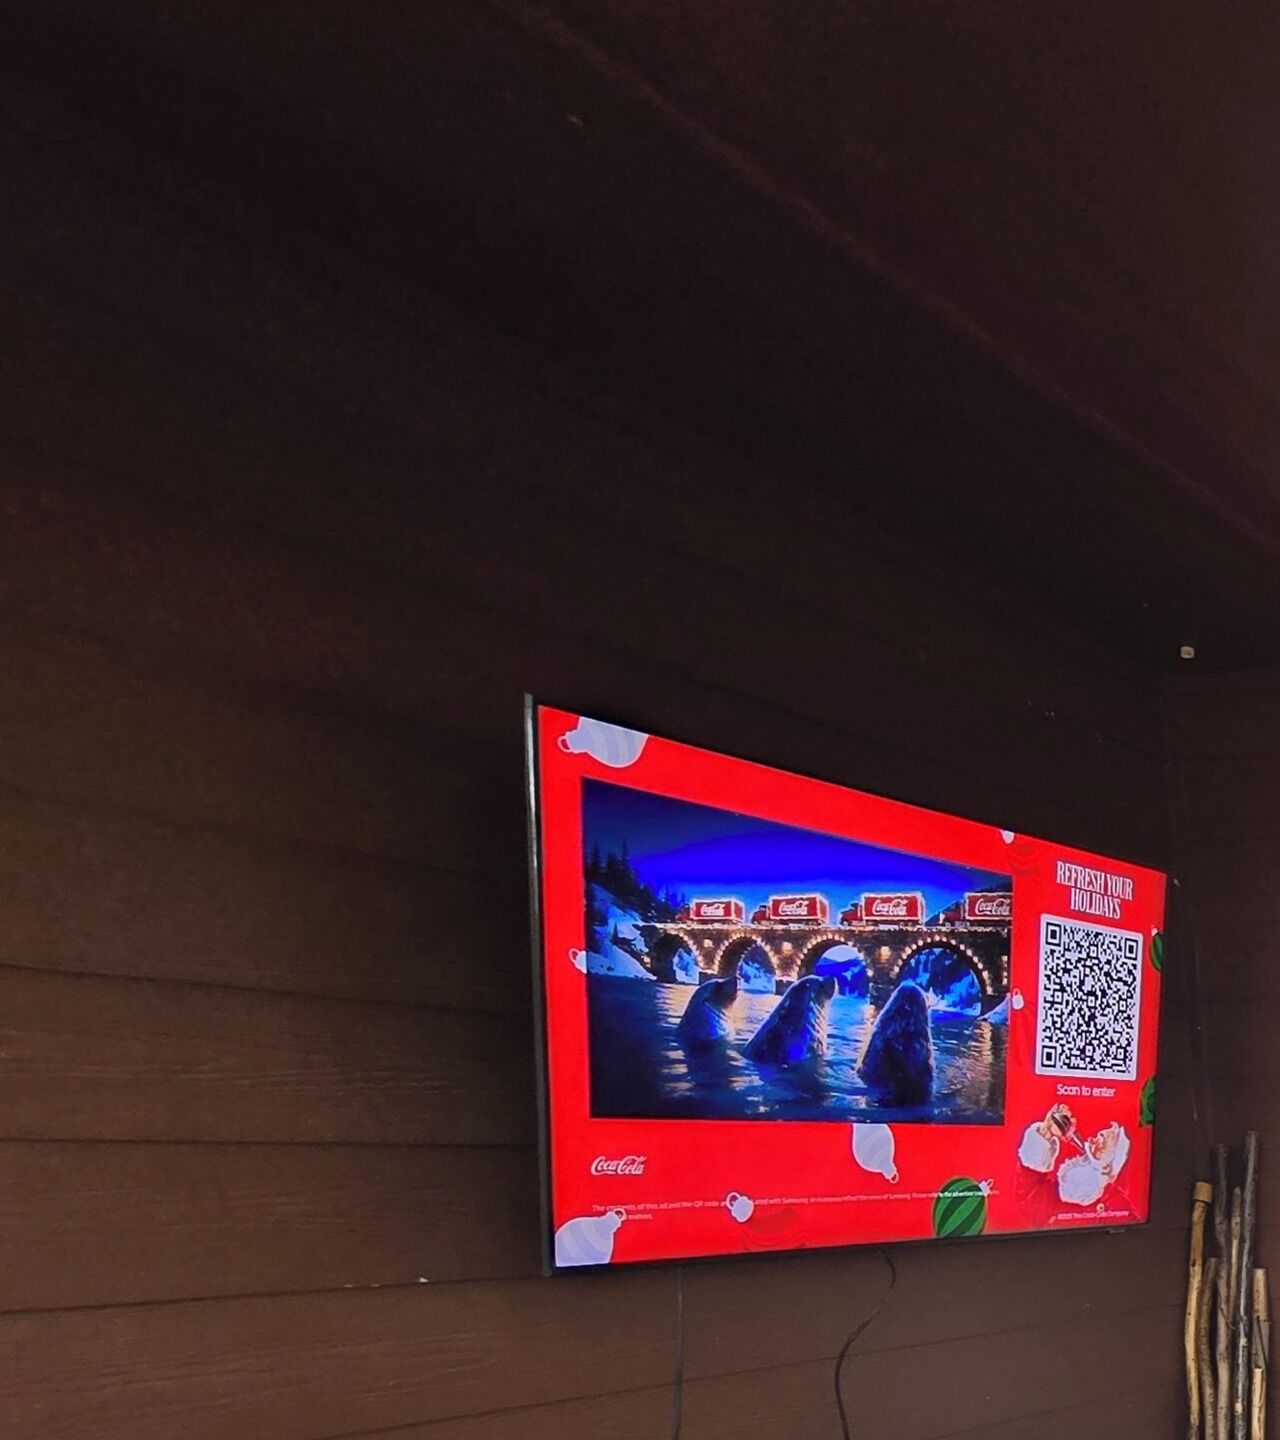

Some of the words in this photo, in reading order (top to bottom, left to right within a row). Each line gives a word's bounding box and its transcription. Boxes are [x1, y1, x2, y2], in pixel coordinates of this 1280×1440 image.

[1056, 861, 1105, 895] REFRESH
[1106, 873, 1133, 901] YOUR
[1070, 887, 1121, 919] HOLIDAYS
[1056, 1083, 1080, 1096] Scan
[1081, 1085, 1091, 1096] to
[1092, 1087, 1116, 1097] enter
